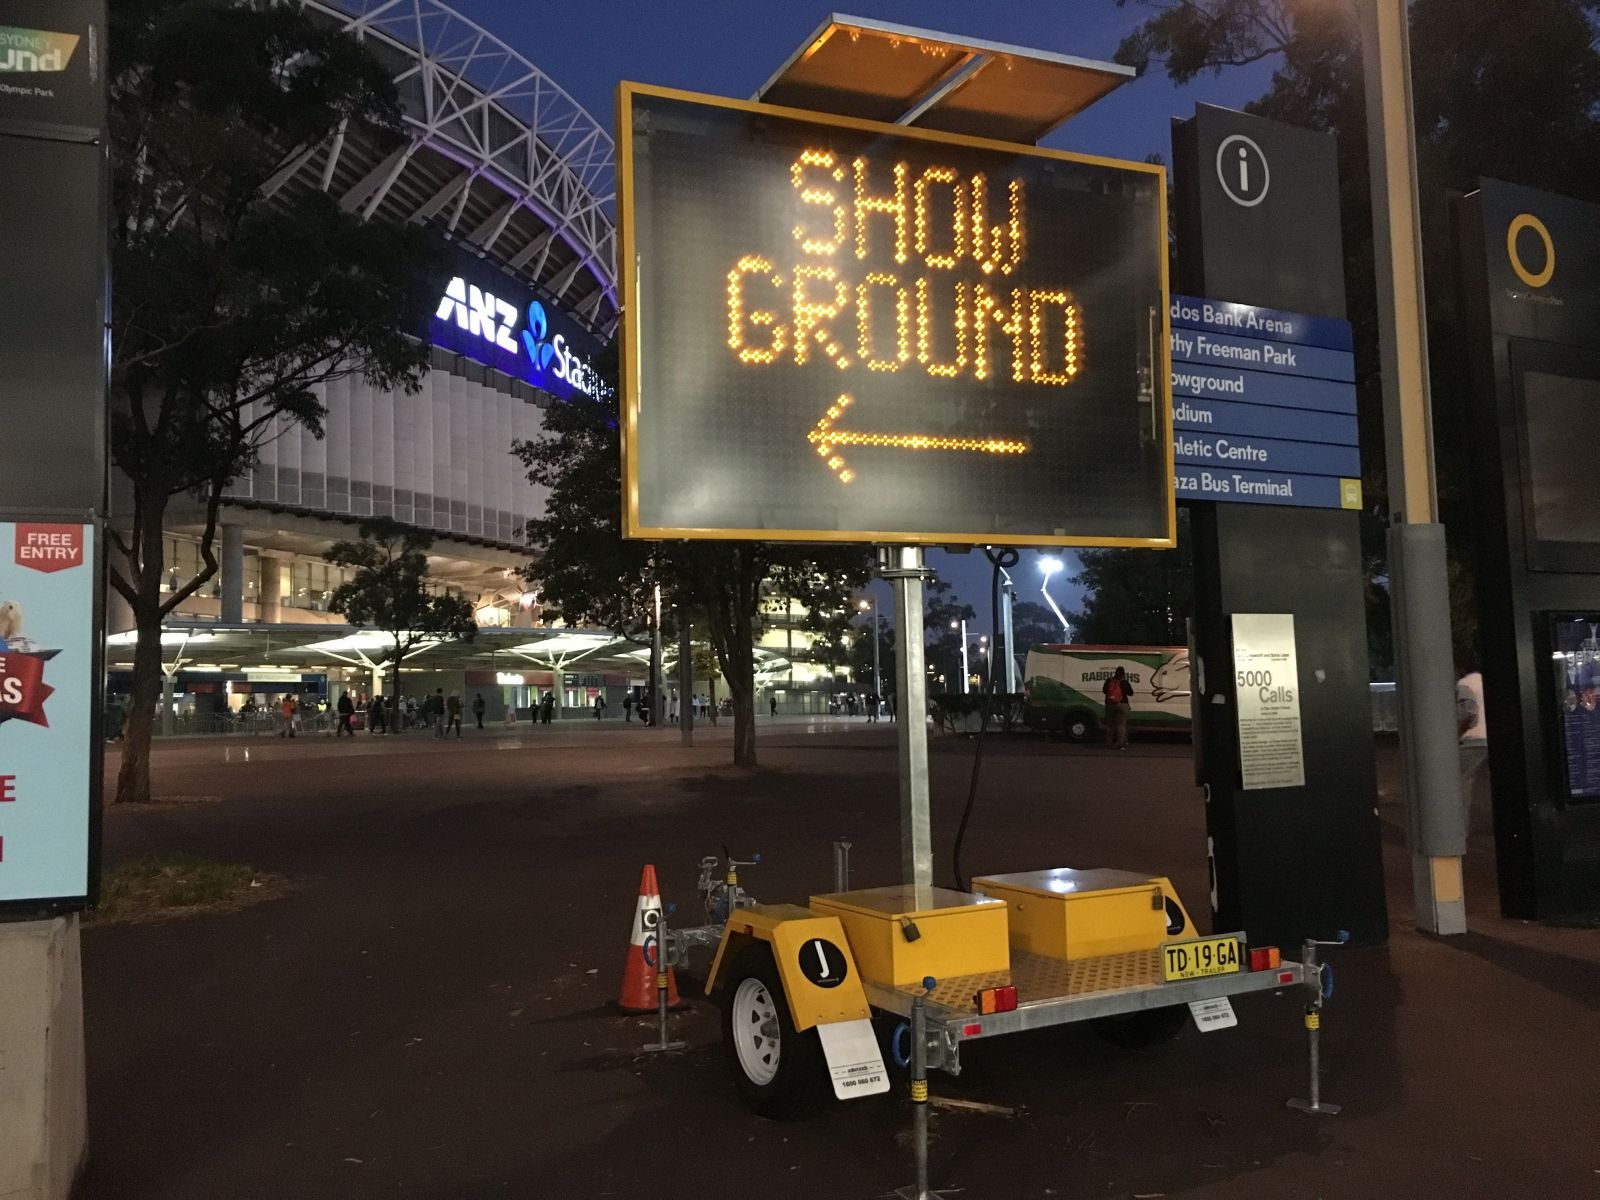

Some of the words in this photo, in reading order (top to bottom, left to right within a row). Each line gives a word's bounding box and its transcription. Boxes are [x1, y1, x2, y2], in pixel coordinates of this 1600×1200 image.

[0, 33, 51, 49] SYDNEY
[34, 87, 55, 98] Park
[790, 149, 1024, 275] SHOW
[435, 276, 518, 355] ANZ
[726, 254, 1080, 386] GROUND
[1170, 300, 1200, 322] dos
[1203, 305, 1243, 327] Bank
[1246, 312, 1293, 335] Arena
[1197, 336, 1261, 362] Freeman
[1263, 346, 1297, 367] Park
[1171, 372, 1245, 394] owground
[1215, 442, 1268, 462] Centre
[1201, 472, 1230, 493] Bus
[1232, 475, 1293, 497] Terminal
[27, 533, 72, 546] FREE
[20, 546, 79, 560] ENTRY
[1237, 670, 1272, 687] 5000
[1259, 686, 1293, 703] Calls
[813, 940, 831, 978] J
[1200, 966, 1225, 975] TRAILER
